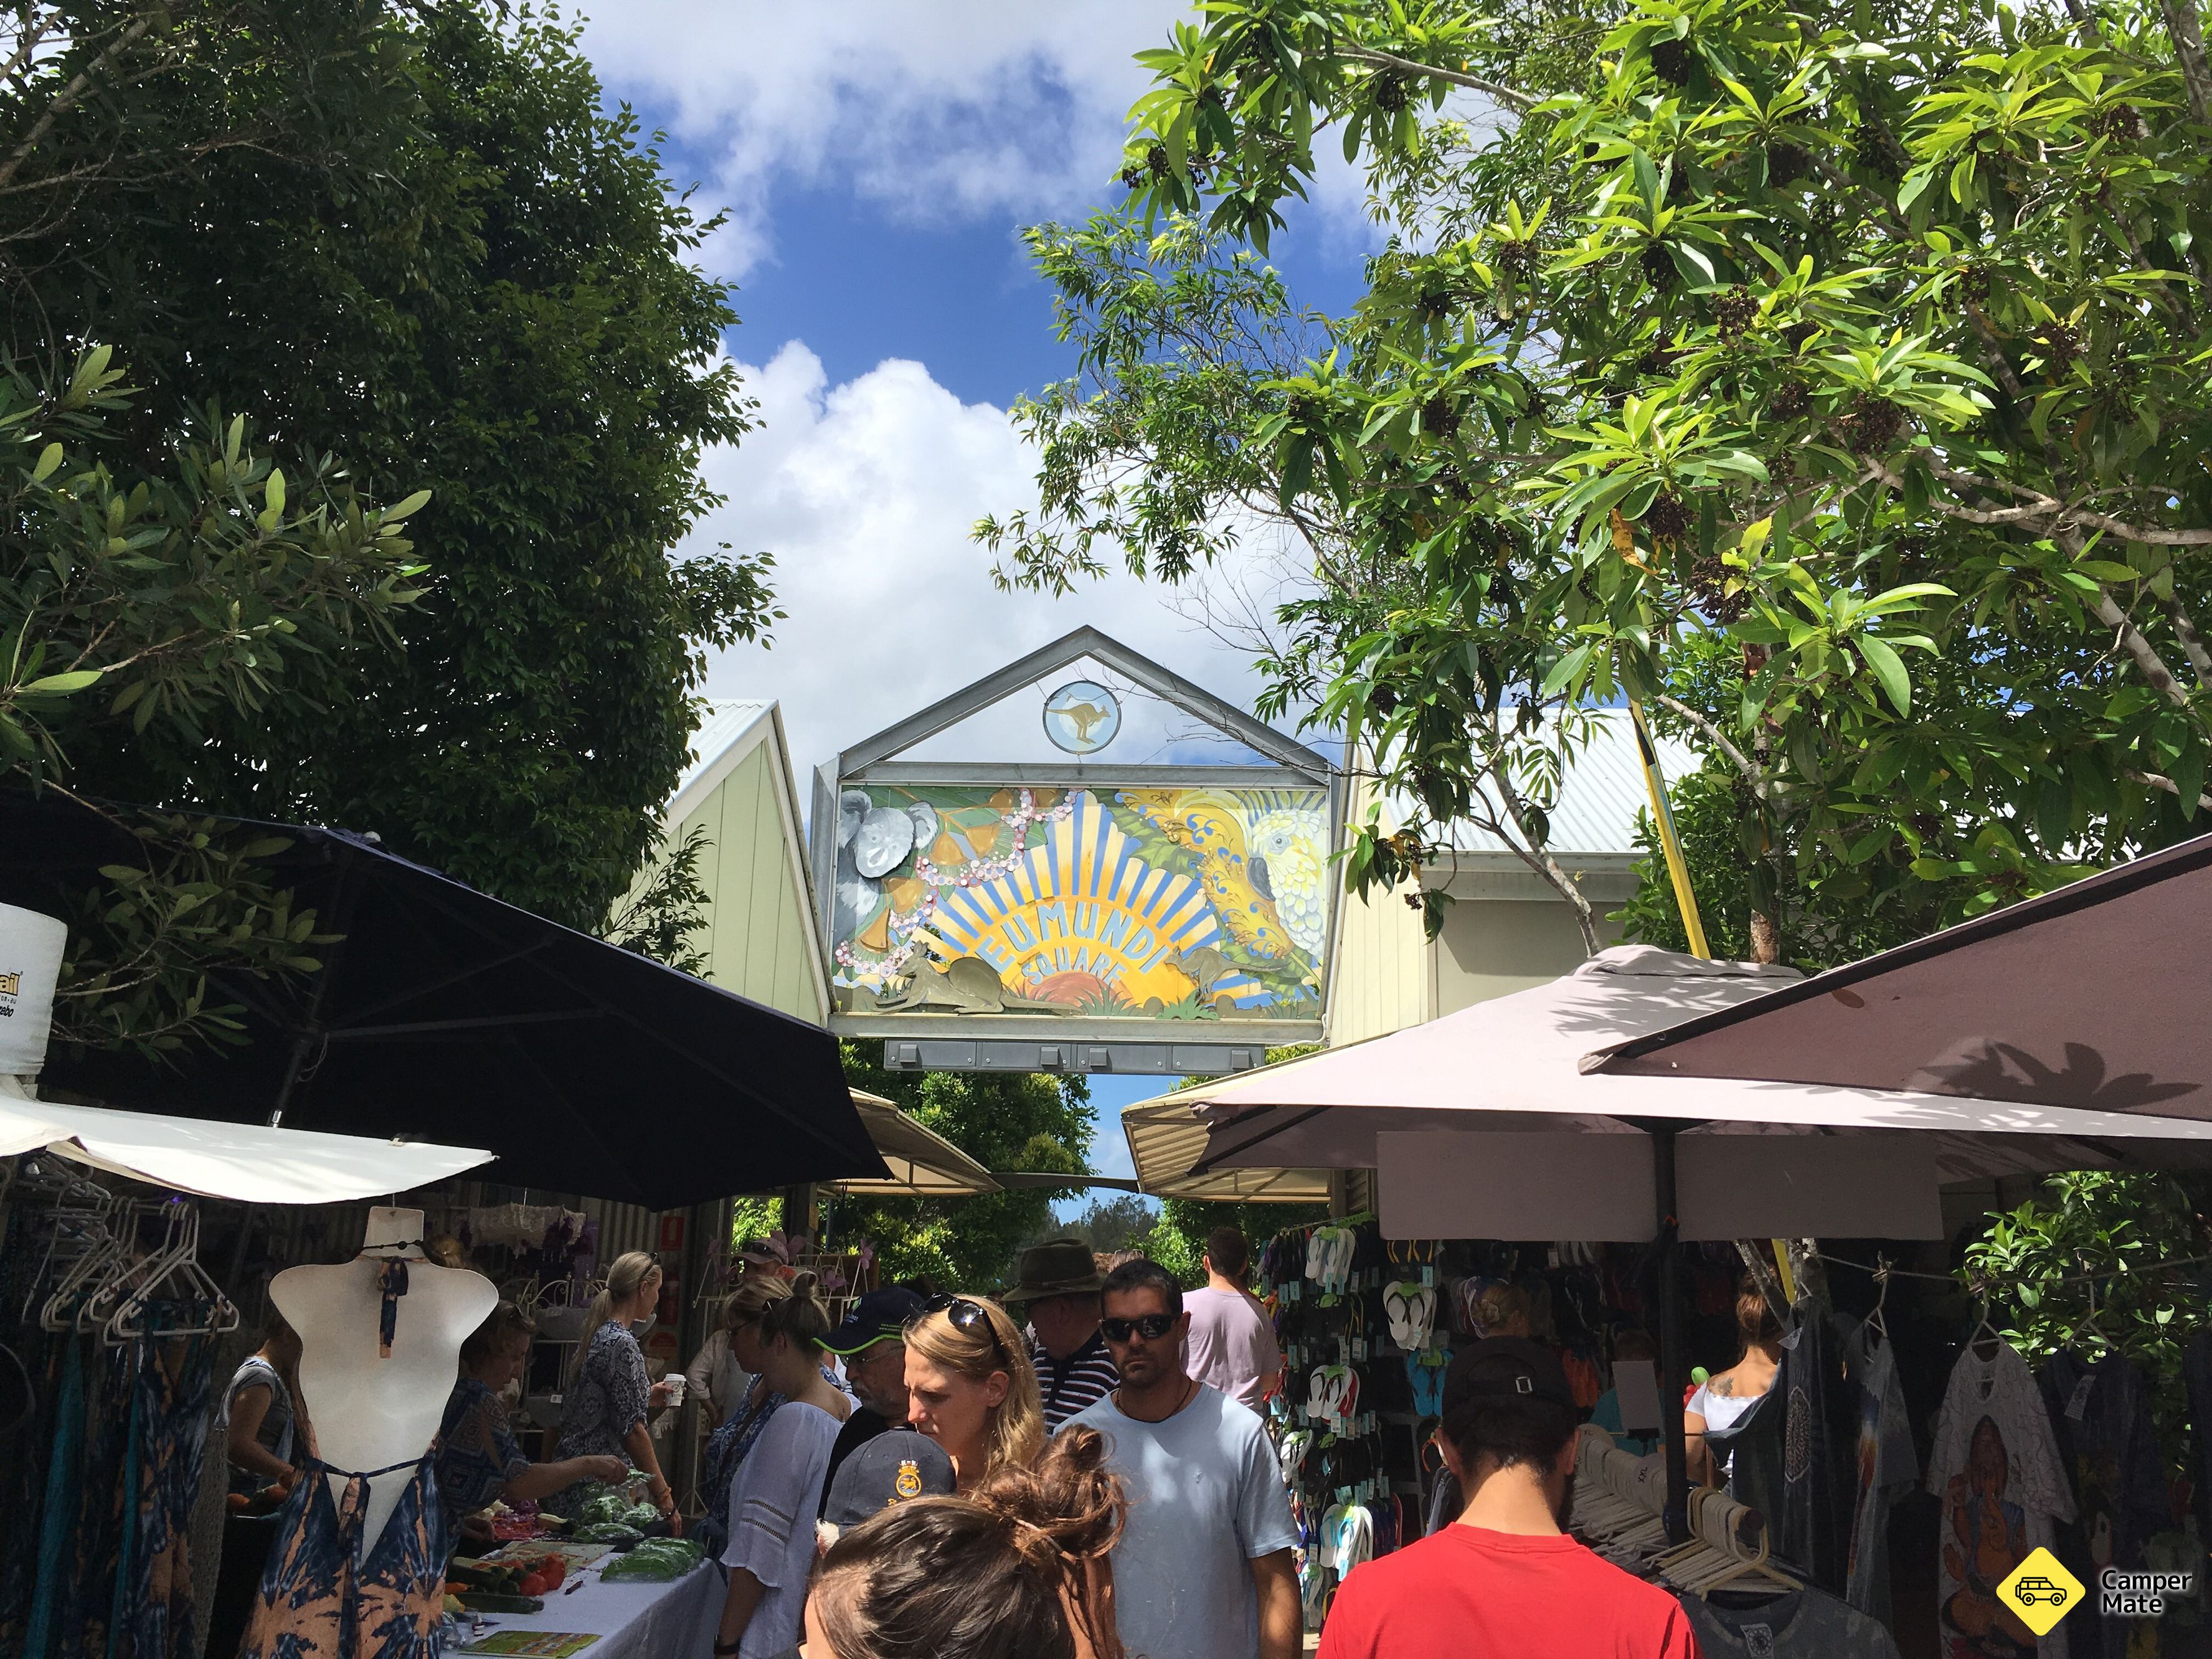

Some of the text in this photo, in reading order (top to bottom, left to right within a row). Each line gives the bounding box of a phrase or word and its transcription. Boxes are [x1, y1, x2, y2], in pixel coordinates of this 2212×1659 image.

[975, 900, 1170, 975] EUMUNDI
[1021, 946, 1127, 988] SQUARE
[1638, 1467, 1648, 1483] XXL
